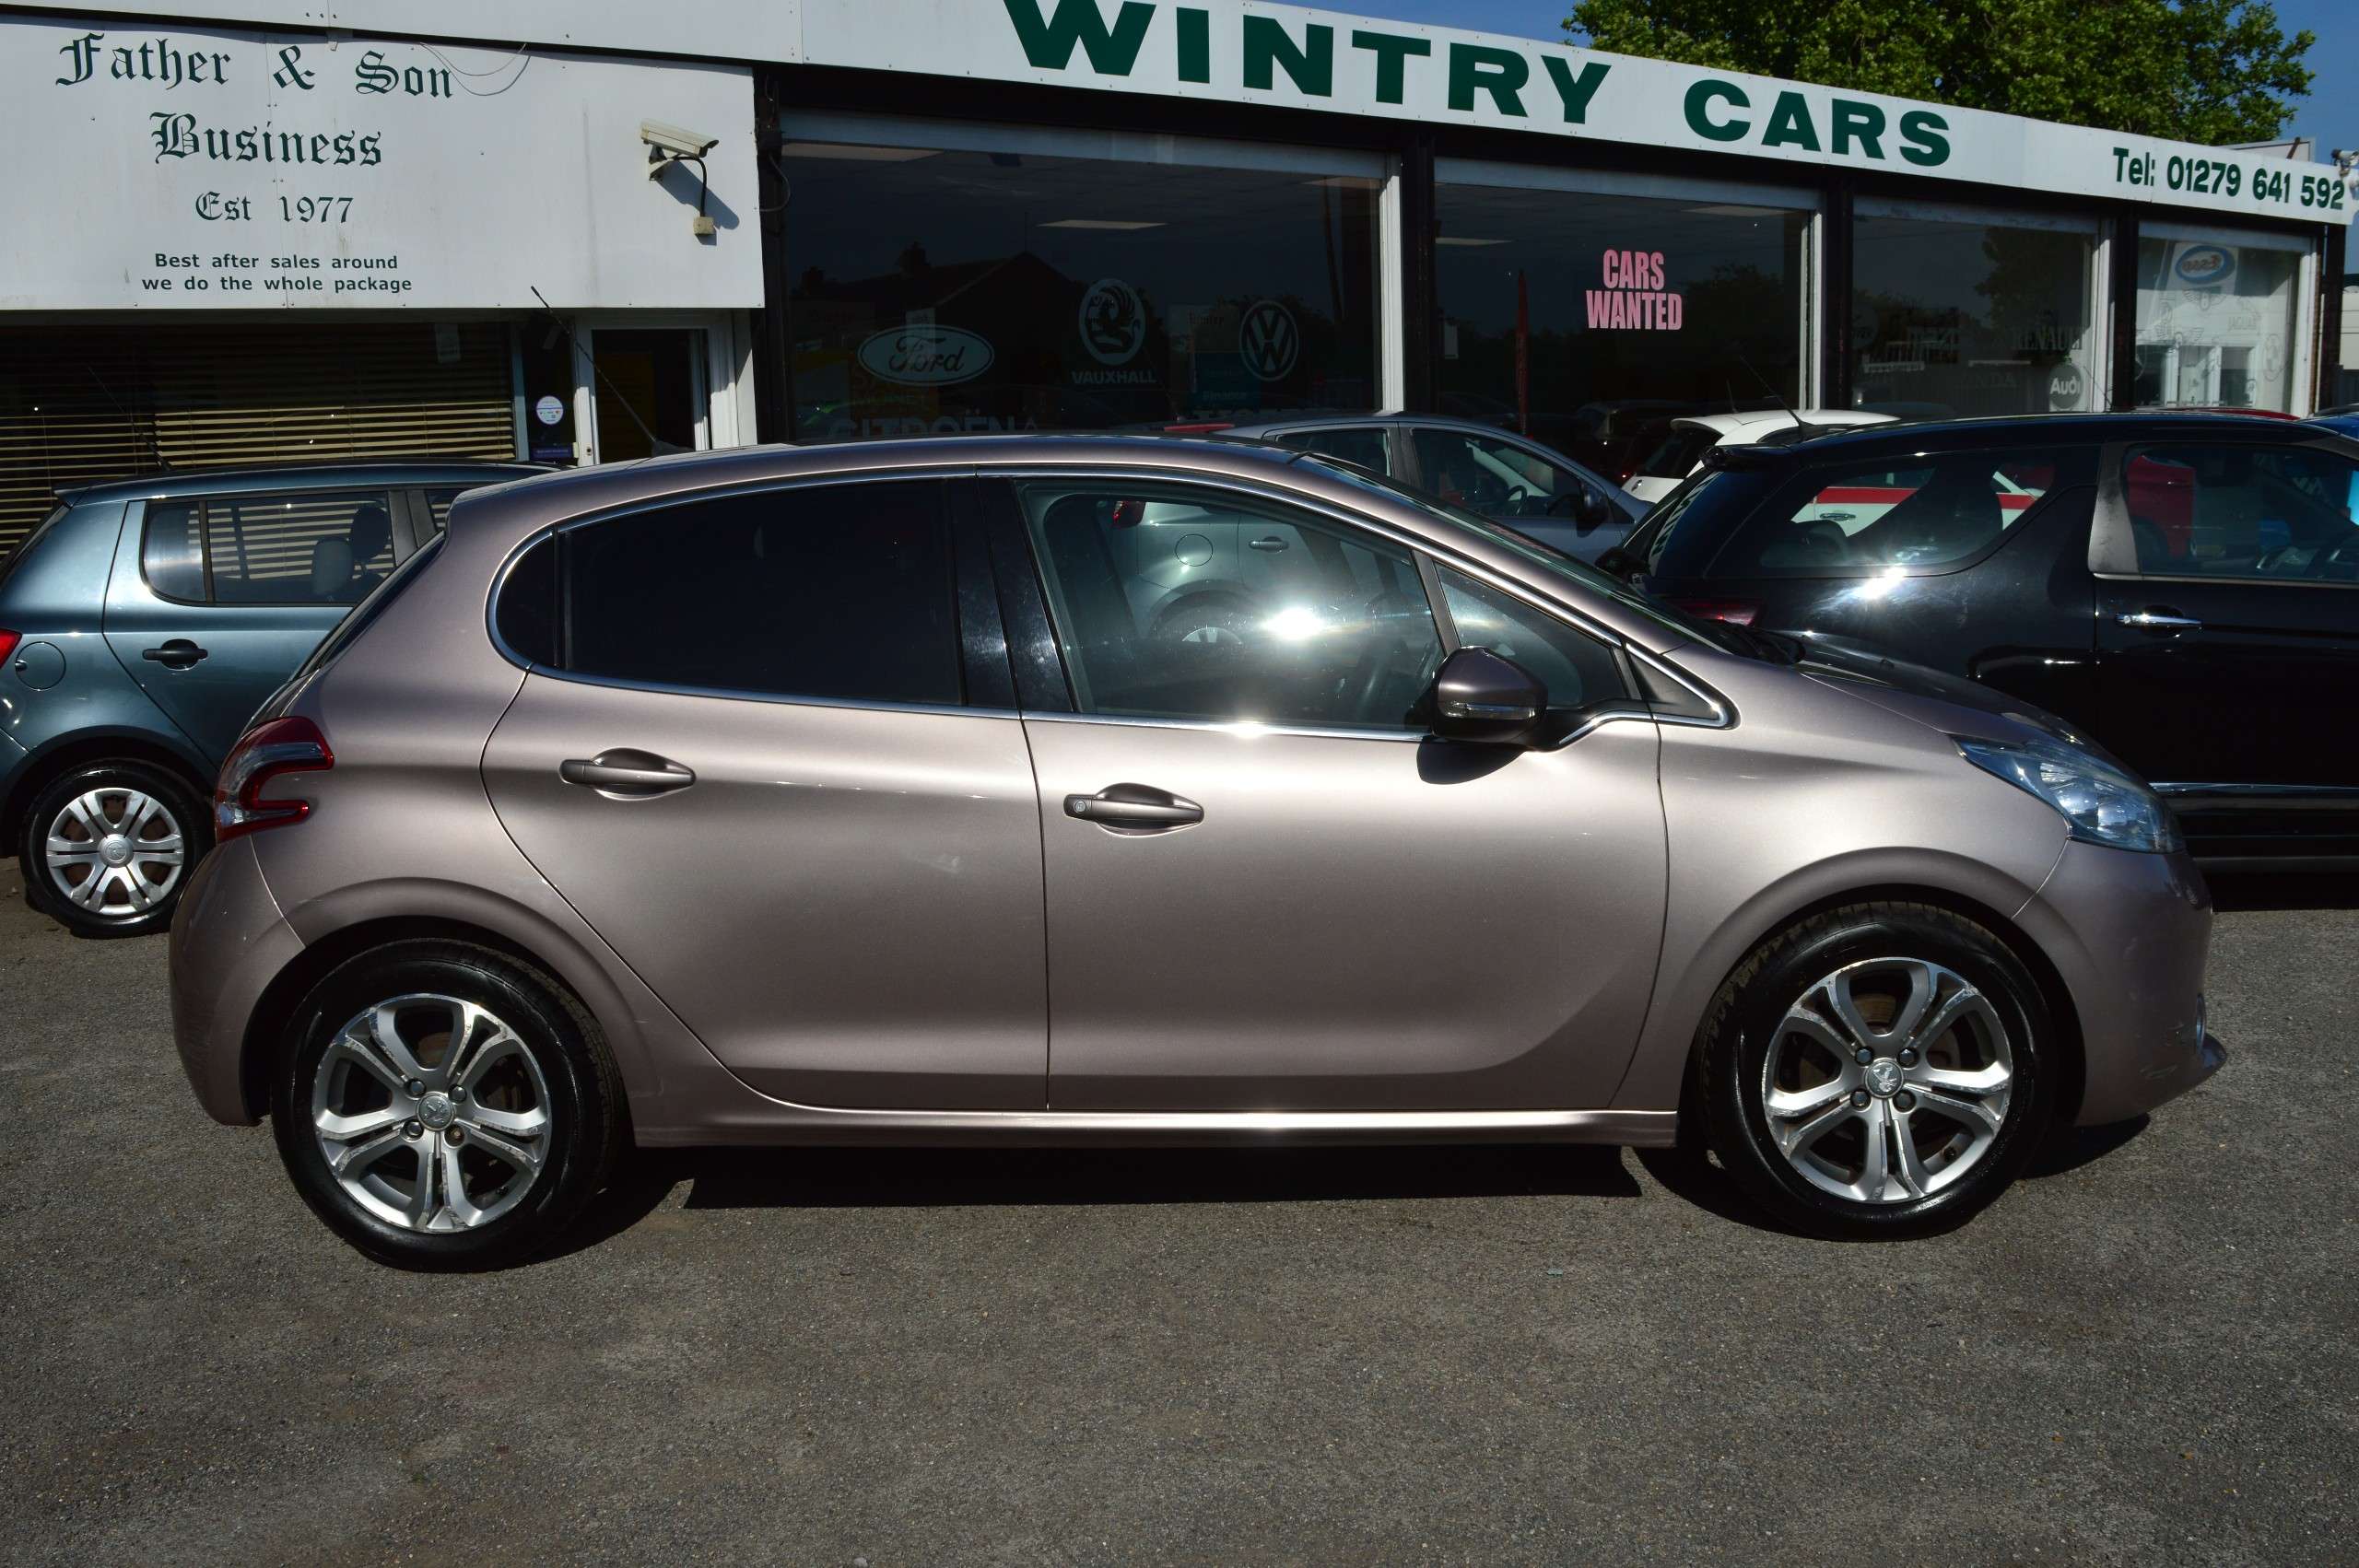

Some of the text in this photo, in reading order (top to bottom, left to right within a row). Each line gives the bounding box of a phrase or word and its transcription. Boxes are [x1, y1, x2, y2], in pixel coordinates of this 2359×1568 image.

[56, 33, 452, 98] Father & Son
[1003, 0, 1951, 167] WINTRY CARS
[150, 112, 381, 166] Business
[2113, 146, 2345, 210] Tel: 01279 641 592
[196, 192, 354, 224] Est 1977
[155, 252, 398, 269] Best after sales around
[1602, 249, 1665, 290] CARS
[142, 275, 412, 294] we do the whole package
[1586, 289, 1683, 331] WANTED
[888, 335, 966, 373] Ford
[1071, 369, 1157, 384] VAUXHALL
